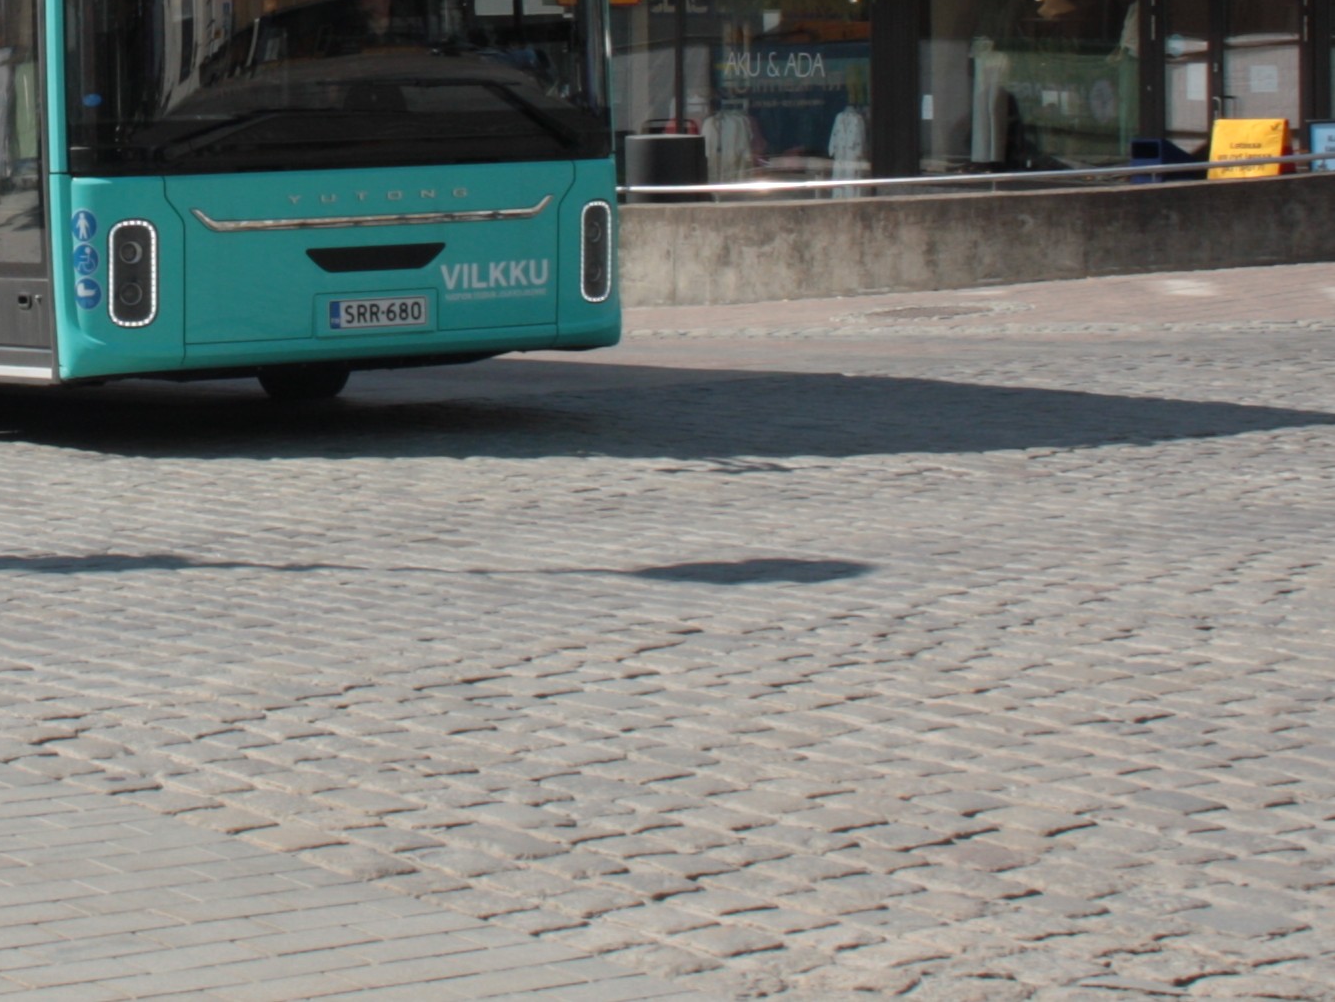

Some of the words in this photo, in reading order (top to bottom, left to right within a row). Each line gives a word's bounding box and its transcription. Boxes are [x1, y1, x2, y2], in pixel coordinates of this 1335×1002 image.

[724, 52, 761, 77] AKU
[767, 51, 780, 77] &
[784, 53, 825, 77] ADA
[289, 187, 469, 204] YUTONG
[440, 259, 550, 290] VILKKU
[344, 302, 422, 324] SRR-680
